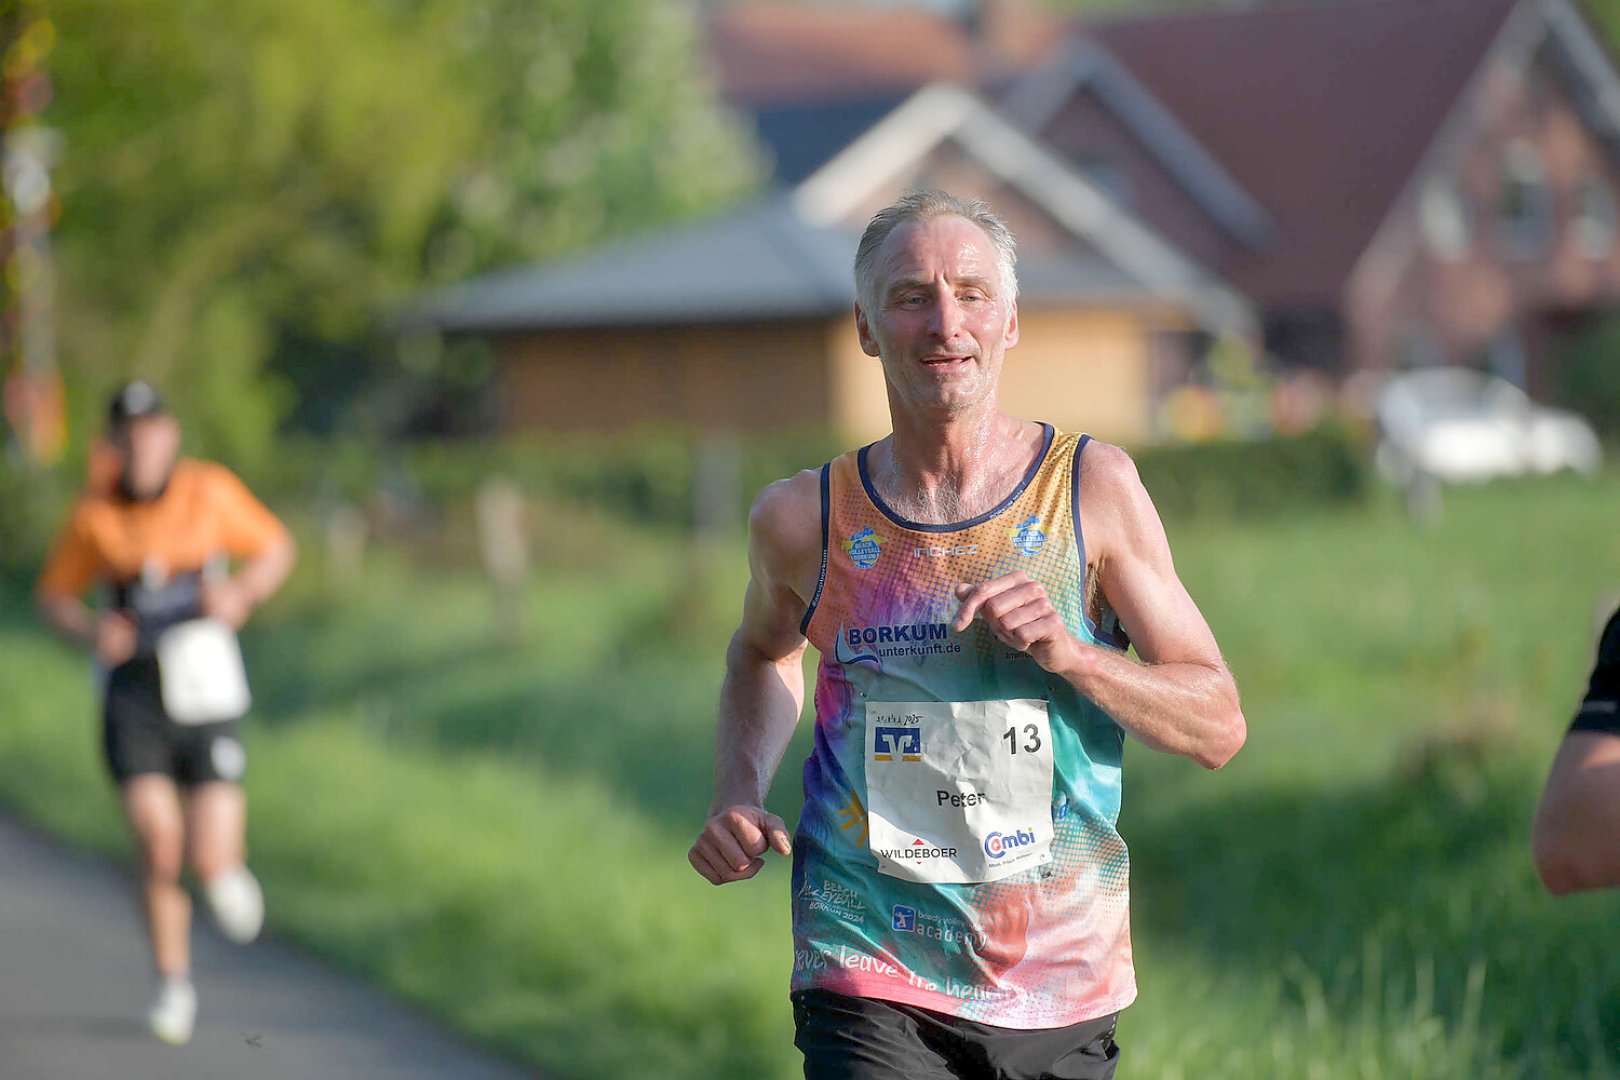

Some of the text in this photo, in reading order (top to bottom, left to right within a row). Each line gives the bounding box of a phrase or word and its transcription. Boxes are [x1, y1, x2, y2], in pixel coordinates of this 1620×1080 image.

[849, 622, 948, 645] BORKUM
[878, 642, 961, 658] unterkunft.de
[1002, 723, 1041, 755] 13
[936, 790, 986, 808] Peter
[880, 848, 958, 859] WILDEBOER
[984, 827, 1036, 859] Combi
[839, 945, 899, 978] leave
